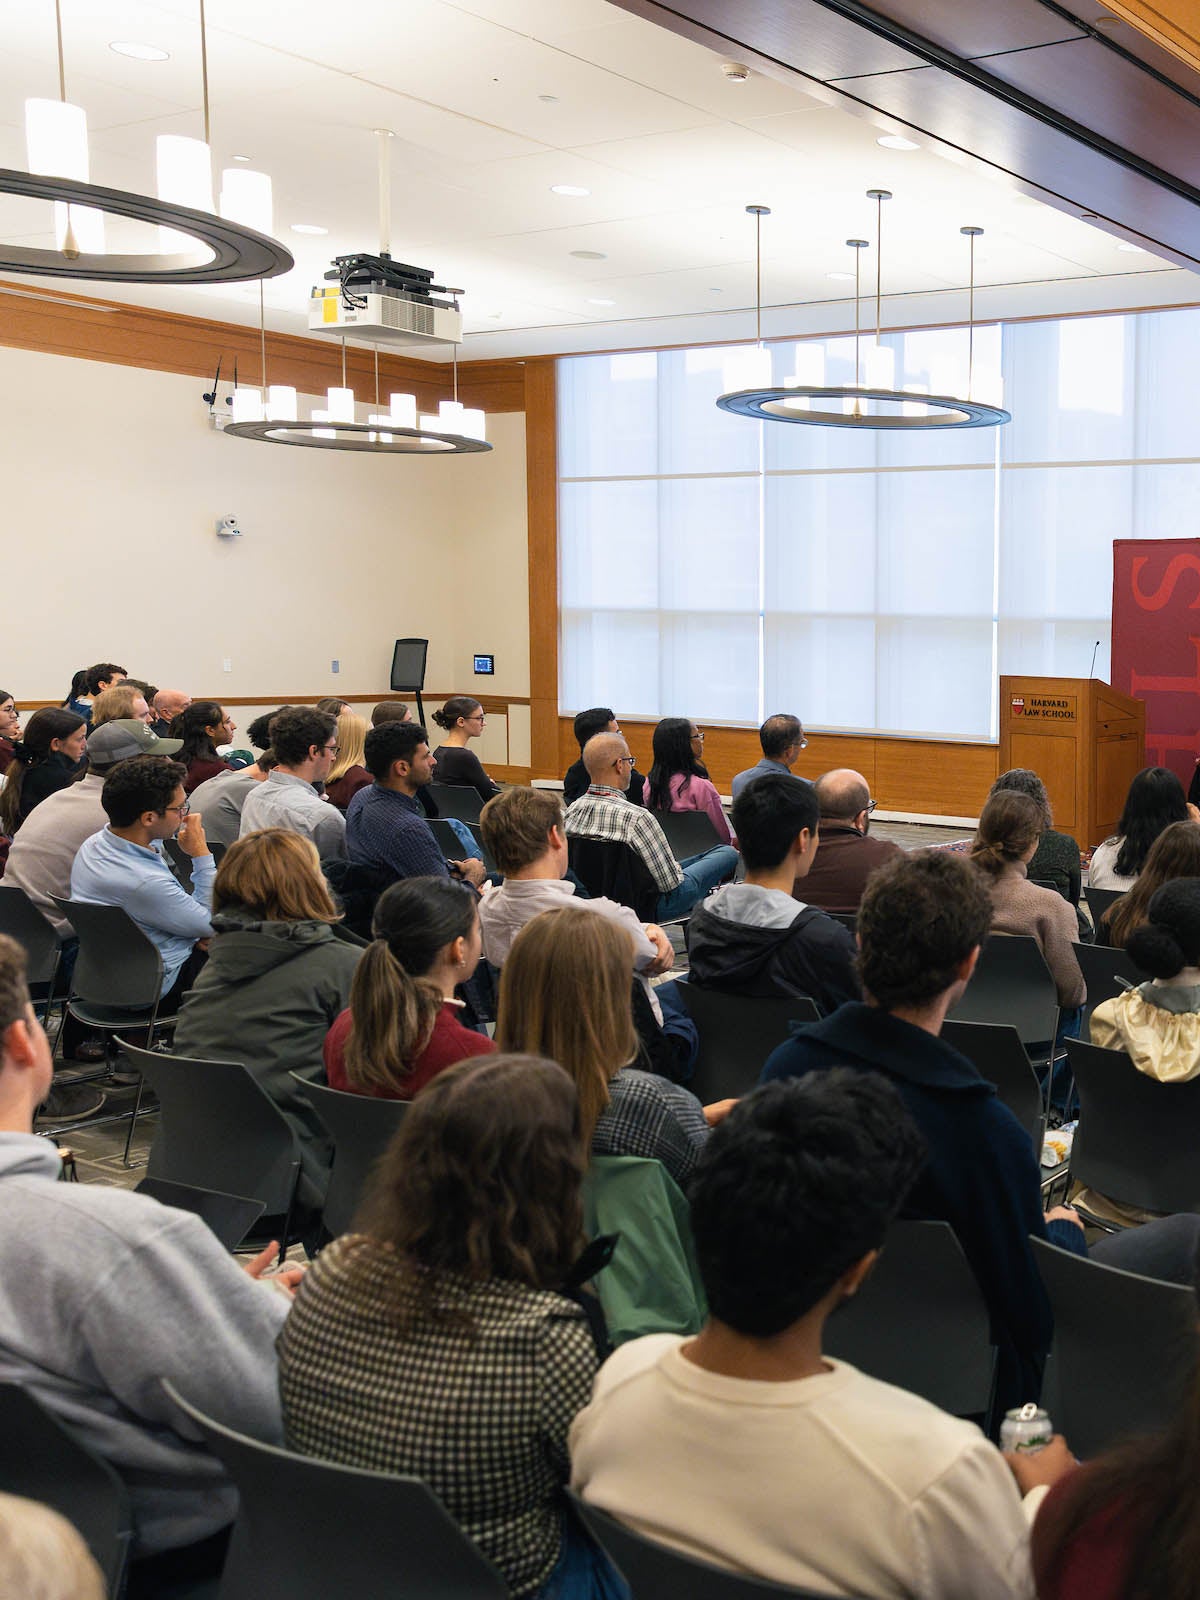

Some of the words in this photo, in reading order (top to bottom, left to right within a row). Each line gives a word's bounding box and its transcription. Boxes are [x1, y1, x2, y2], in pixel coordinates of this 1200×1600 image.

[1031, 699, 1068, 707] HARVARD
[1024, 708, 1039, 716] LAW
[1042, 709, 1075, 718] SCHOOL
